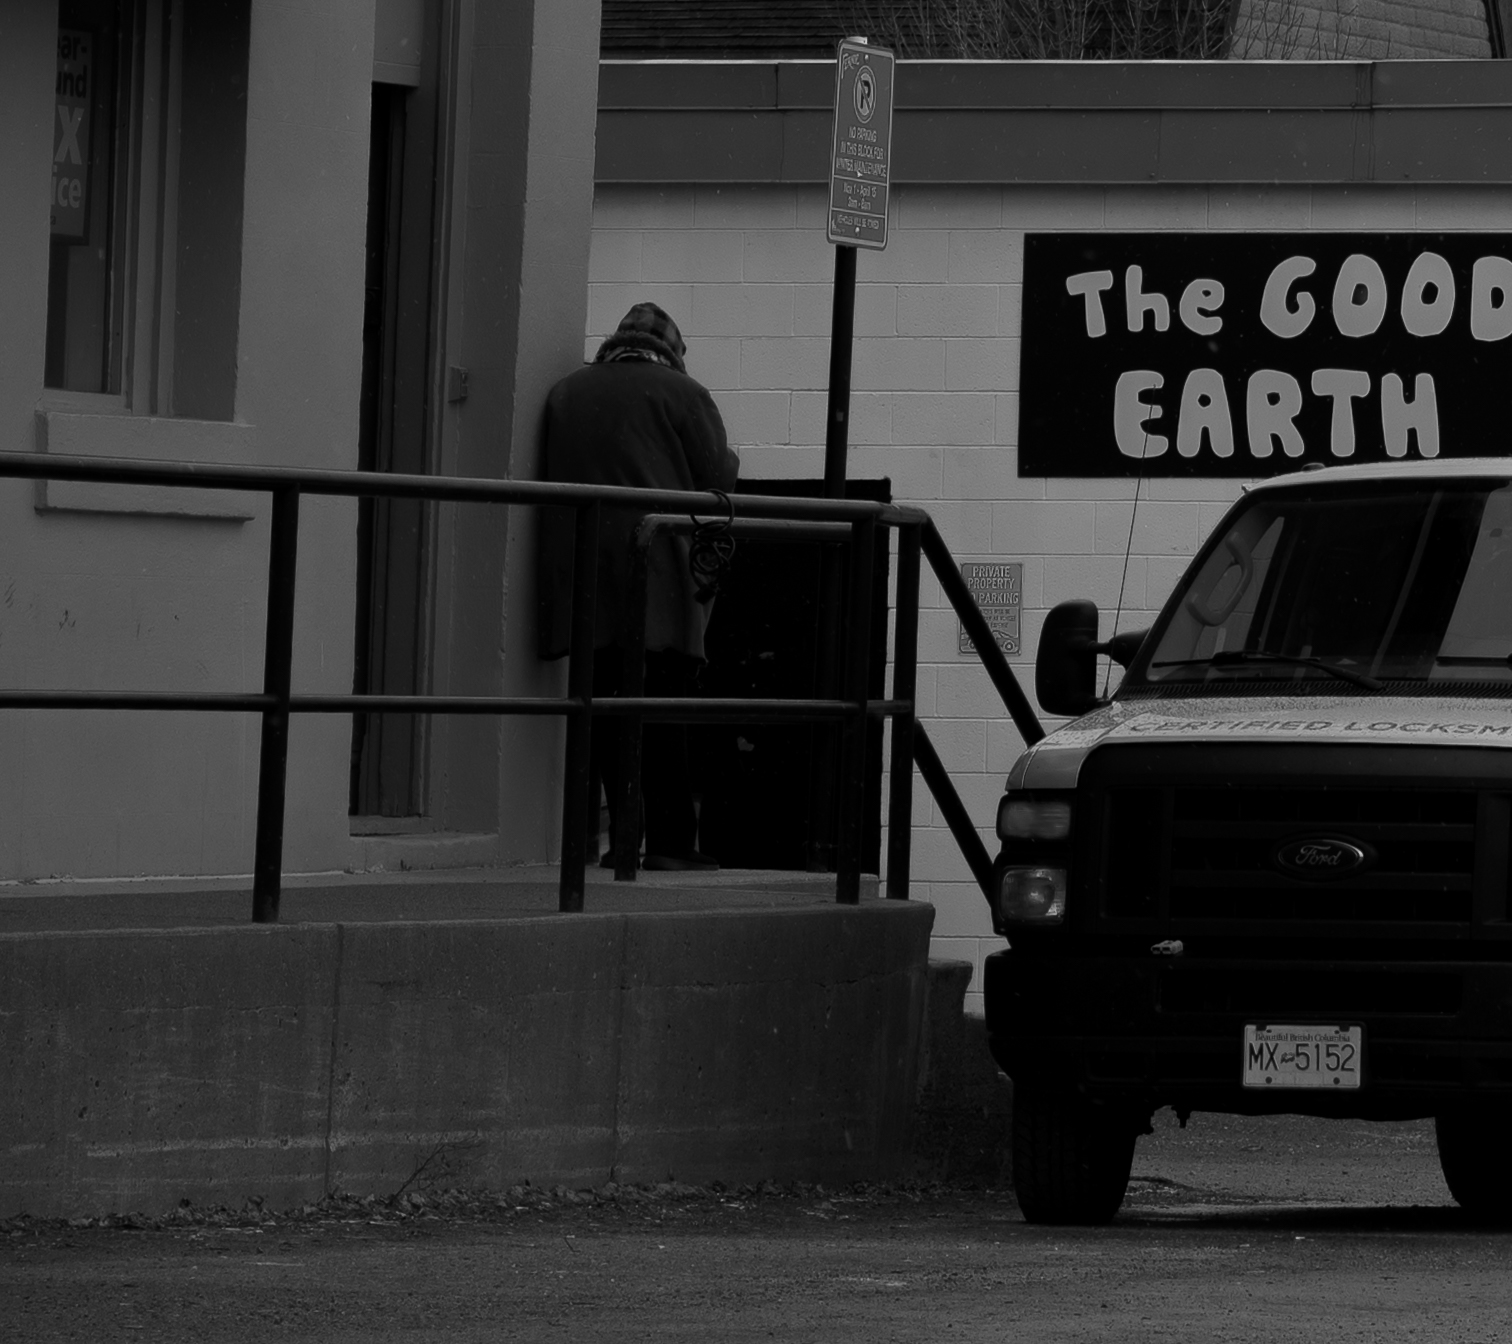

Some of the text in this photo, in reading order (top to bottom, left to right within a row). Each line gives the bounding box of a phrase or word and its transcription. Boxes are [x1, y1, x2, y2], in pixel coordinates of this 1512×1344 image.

[57, 33, 87, 61] ar-
[857, 127, 877, 142] PARKING
[1065, 264, 1225, 339] The
[1113, 368, 1440, 459] EARTH
[972, 565, 1011, 578] PRIVATE
[967, 577, 1015, 590] PROPERTY
[978, 592, 1019, 604] PARKING
[1130, 720, 1333, 732] CERTIFIED
[1295, 844, 1342, 865] Ford
[1255, 1033, 1350, 1042] Beautiful British Columbia
